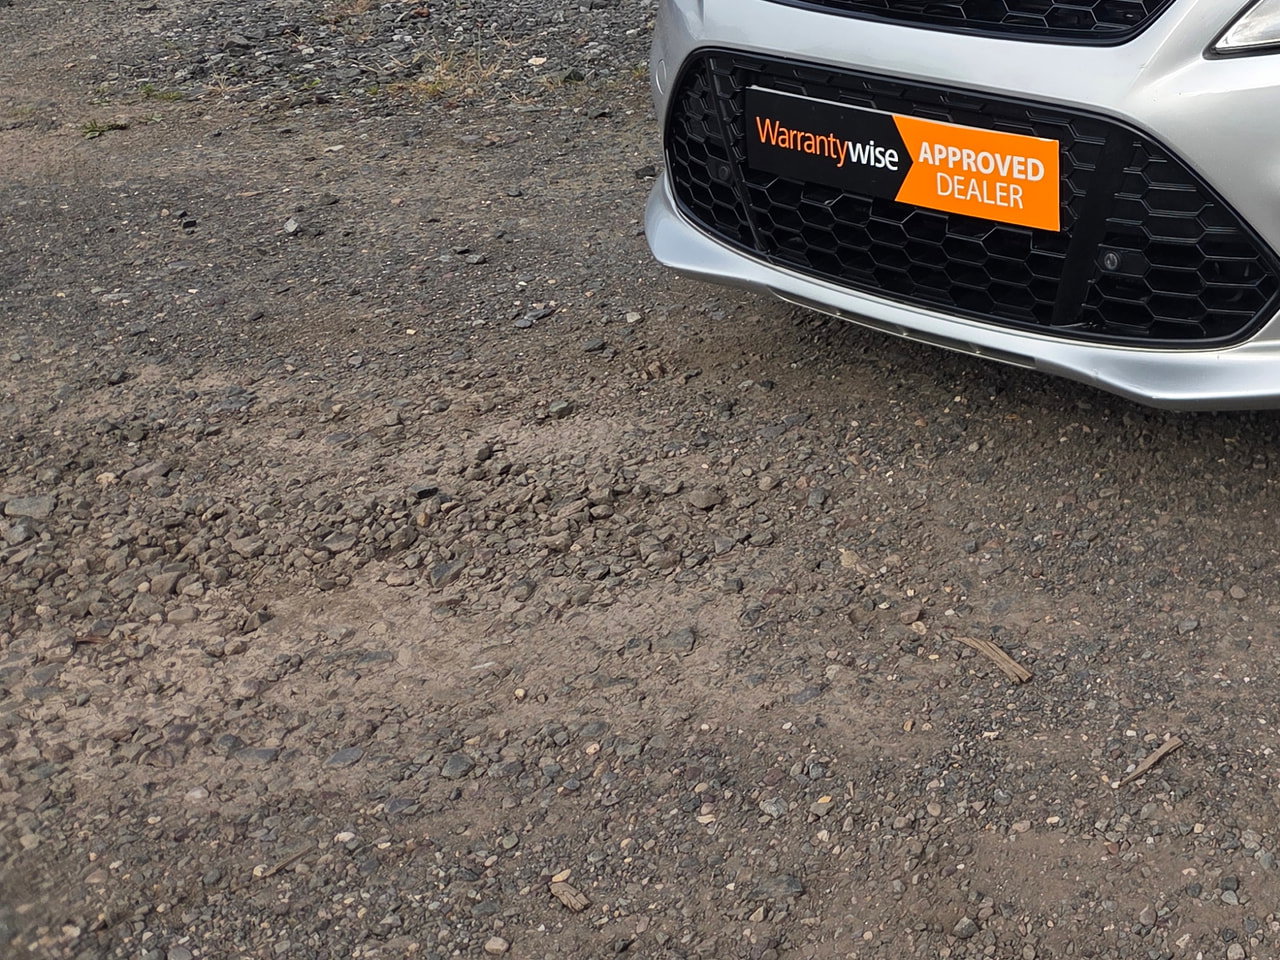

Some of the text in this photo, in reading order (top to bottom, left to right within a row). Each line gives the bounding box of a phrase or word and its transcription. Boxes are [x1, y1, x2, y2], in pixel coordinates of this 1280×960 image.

[755, 116, 899, 171] Warrantywise
[918, 142, 1045, 182] APPROVED
[936, 172, 1024, 210] DEALER
